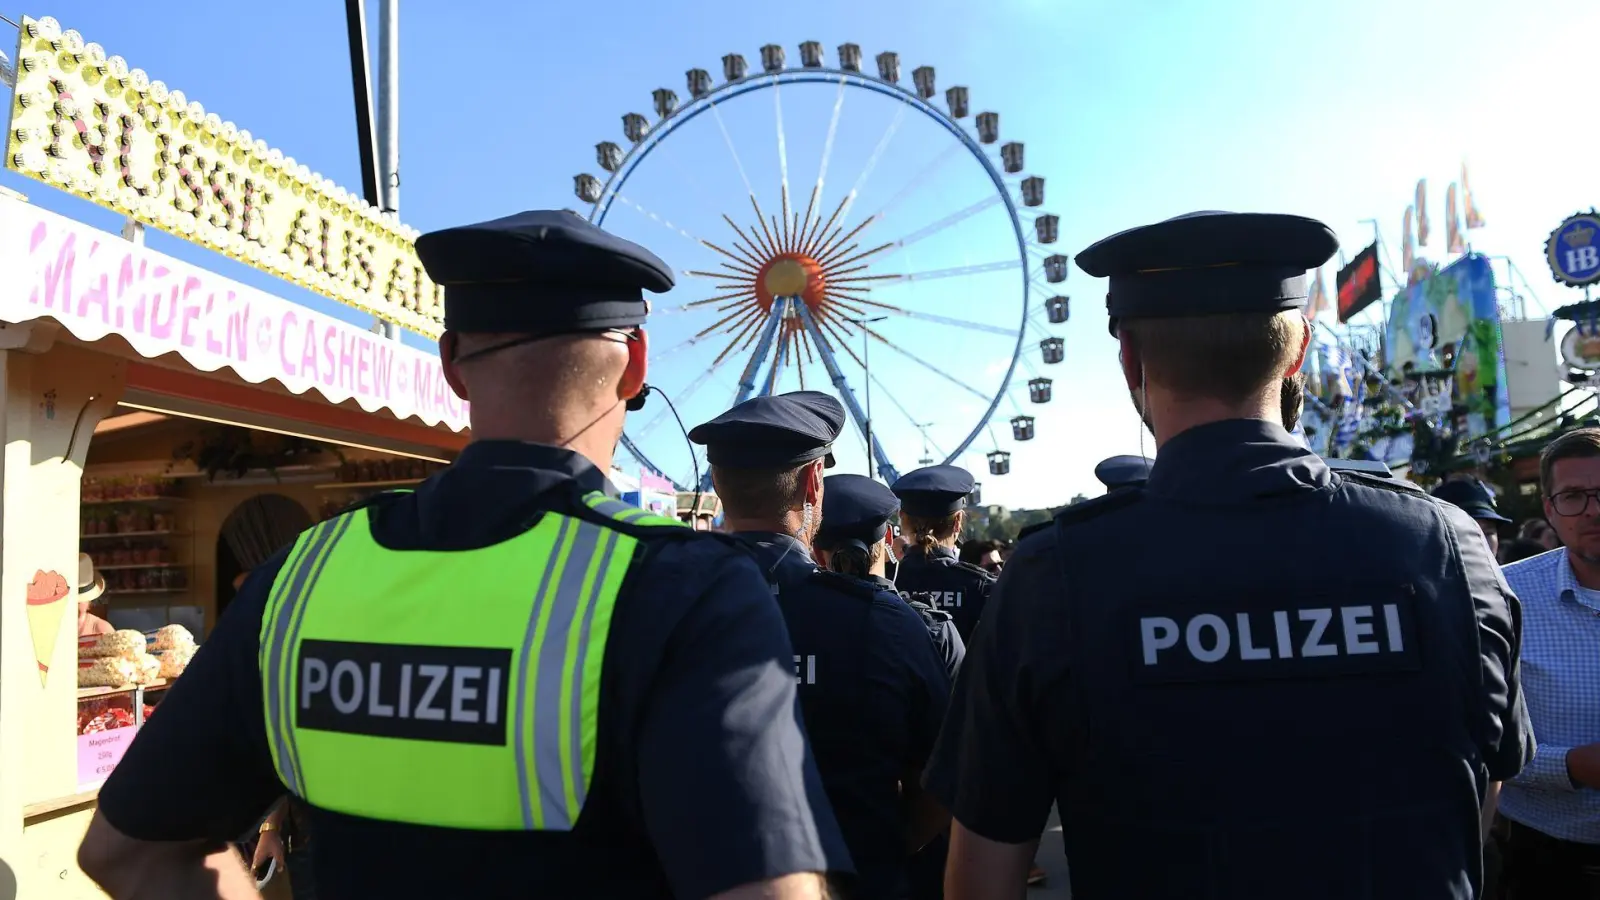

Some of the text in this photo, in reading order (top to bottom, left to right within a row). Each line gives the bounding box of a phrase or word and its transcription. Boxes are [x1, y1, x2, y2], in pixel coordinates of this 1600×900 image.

[281, 209, 375, 292] AUS
[1565, 246, 1599, 274] HB
[28, 220, 249, 363] MANDELN
[279, 311, 394, 400] CASHEW
[1140, 603, 1404, 665] POLIZEI
[301, 657, 501, 724] POLIZEI
